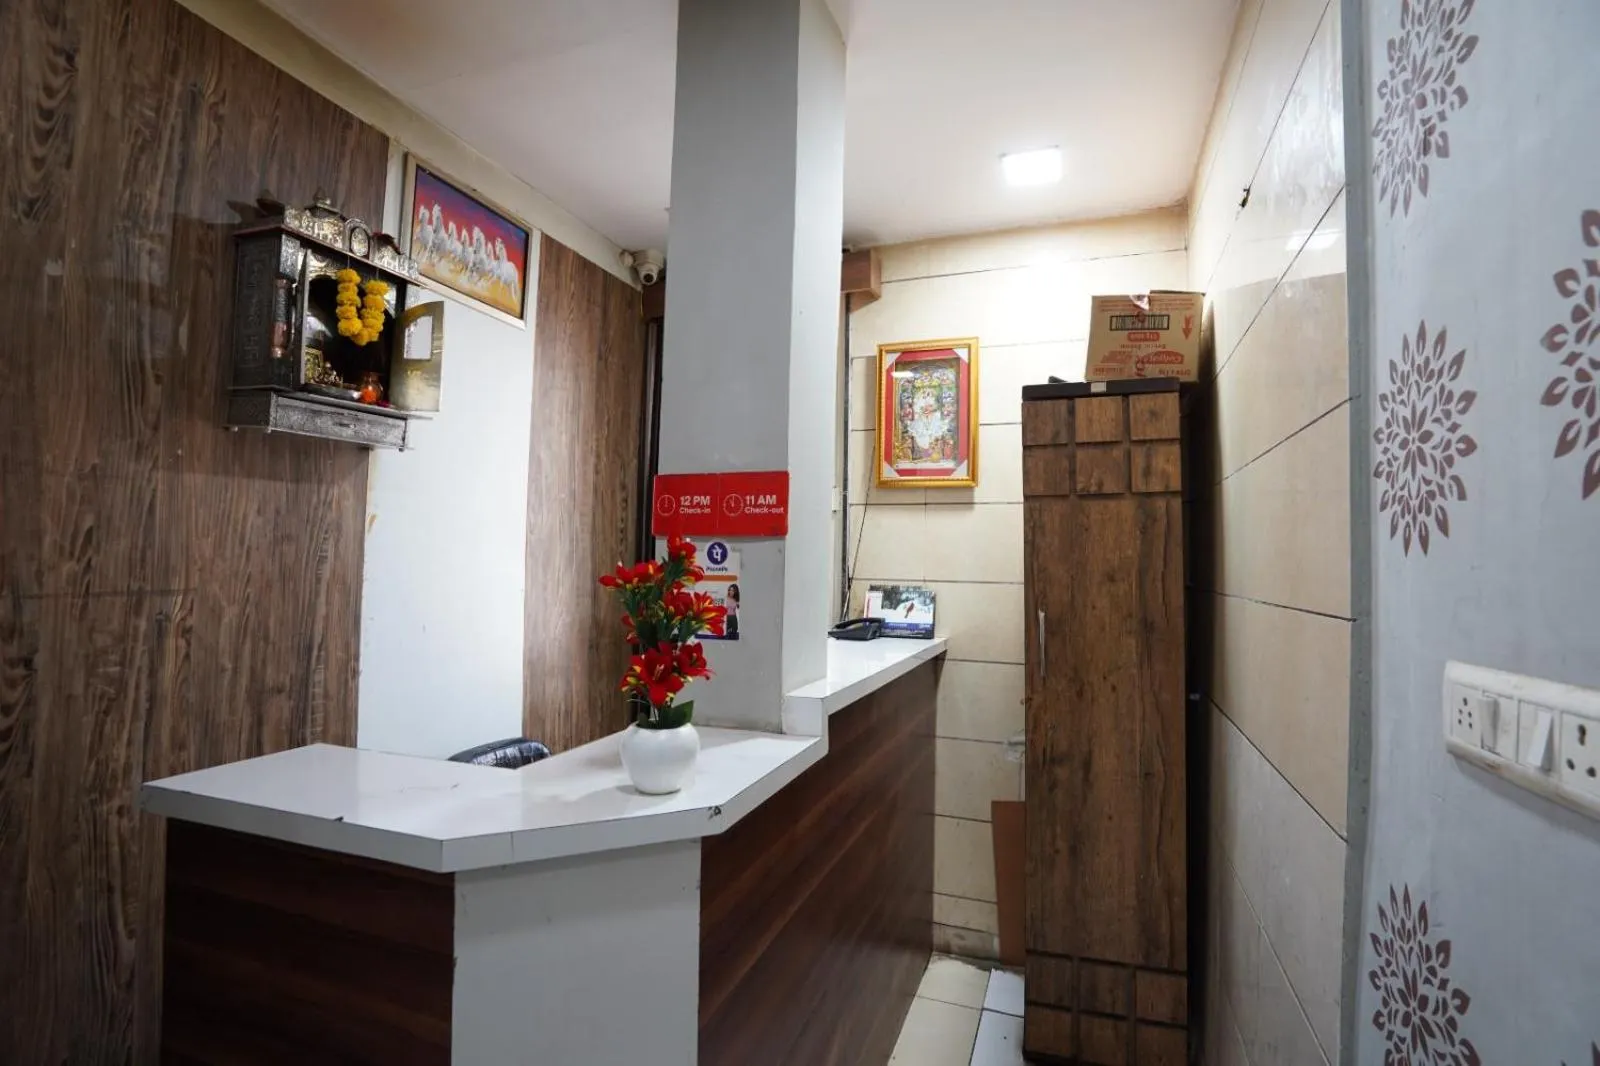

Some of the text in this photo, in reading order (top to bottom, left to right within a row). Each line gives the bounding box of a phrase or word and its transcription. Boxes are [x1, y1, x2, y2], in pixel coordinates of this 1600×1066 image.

[680, 496, 710, 505] 12 PM
[745, 494, 776, 505] 11 AM
[744, 506, 784, 514] Check-out
